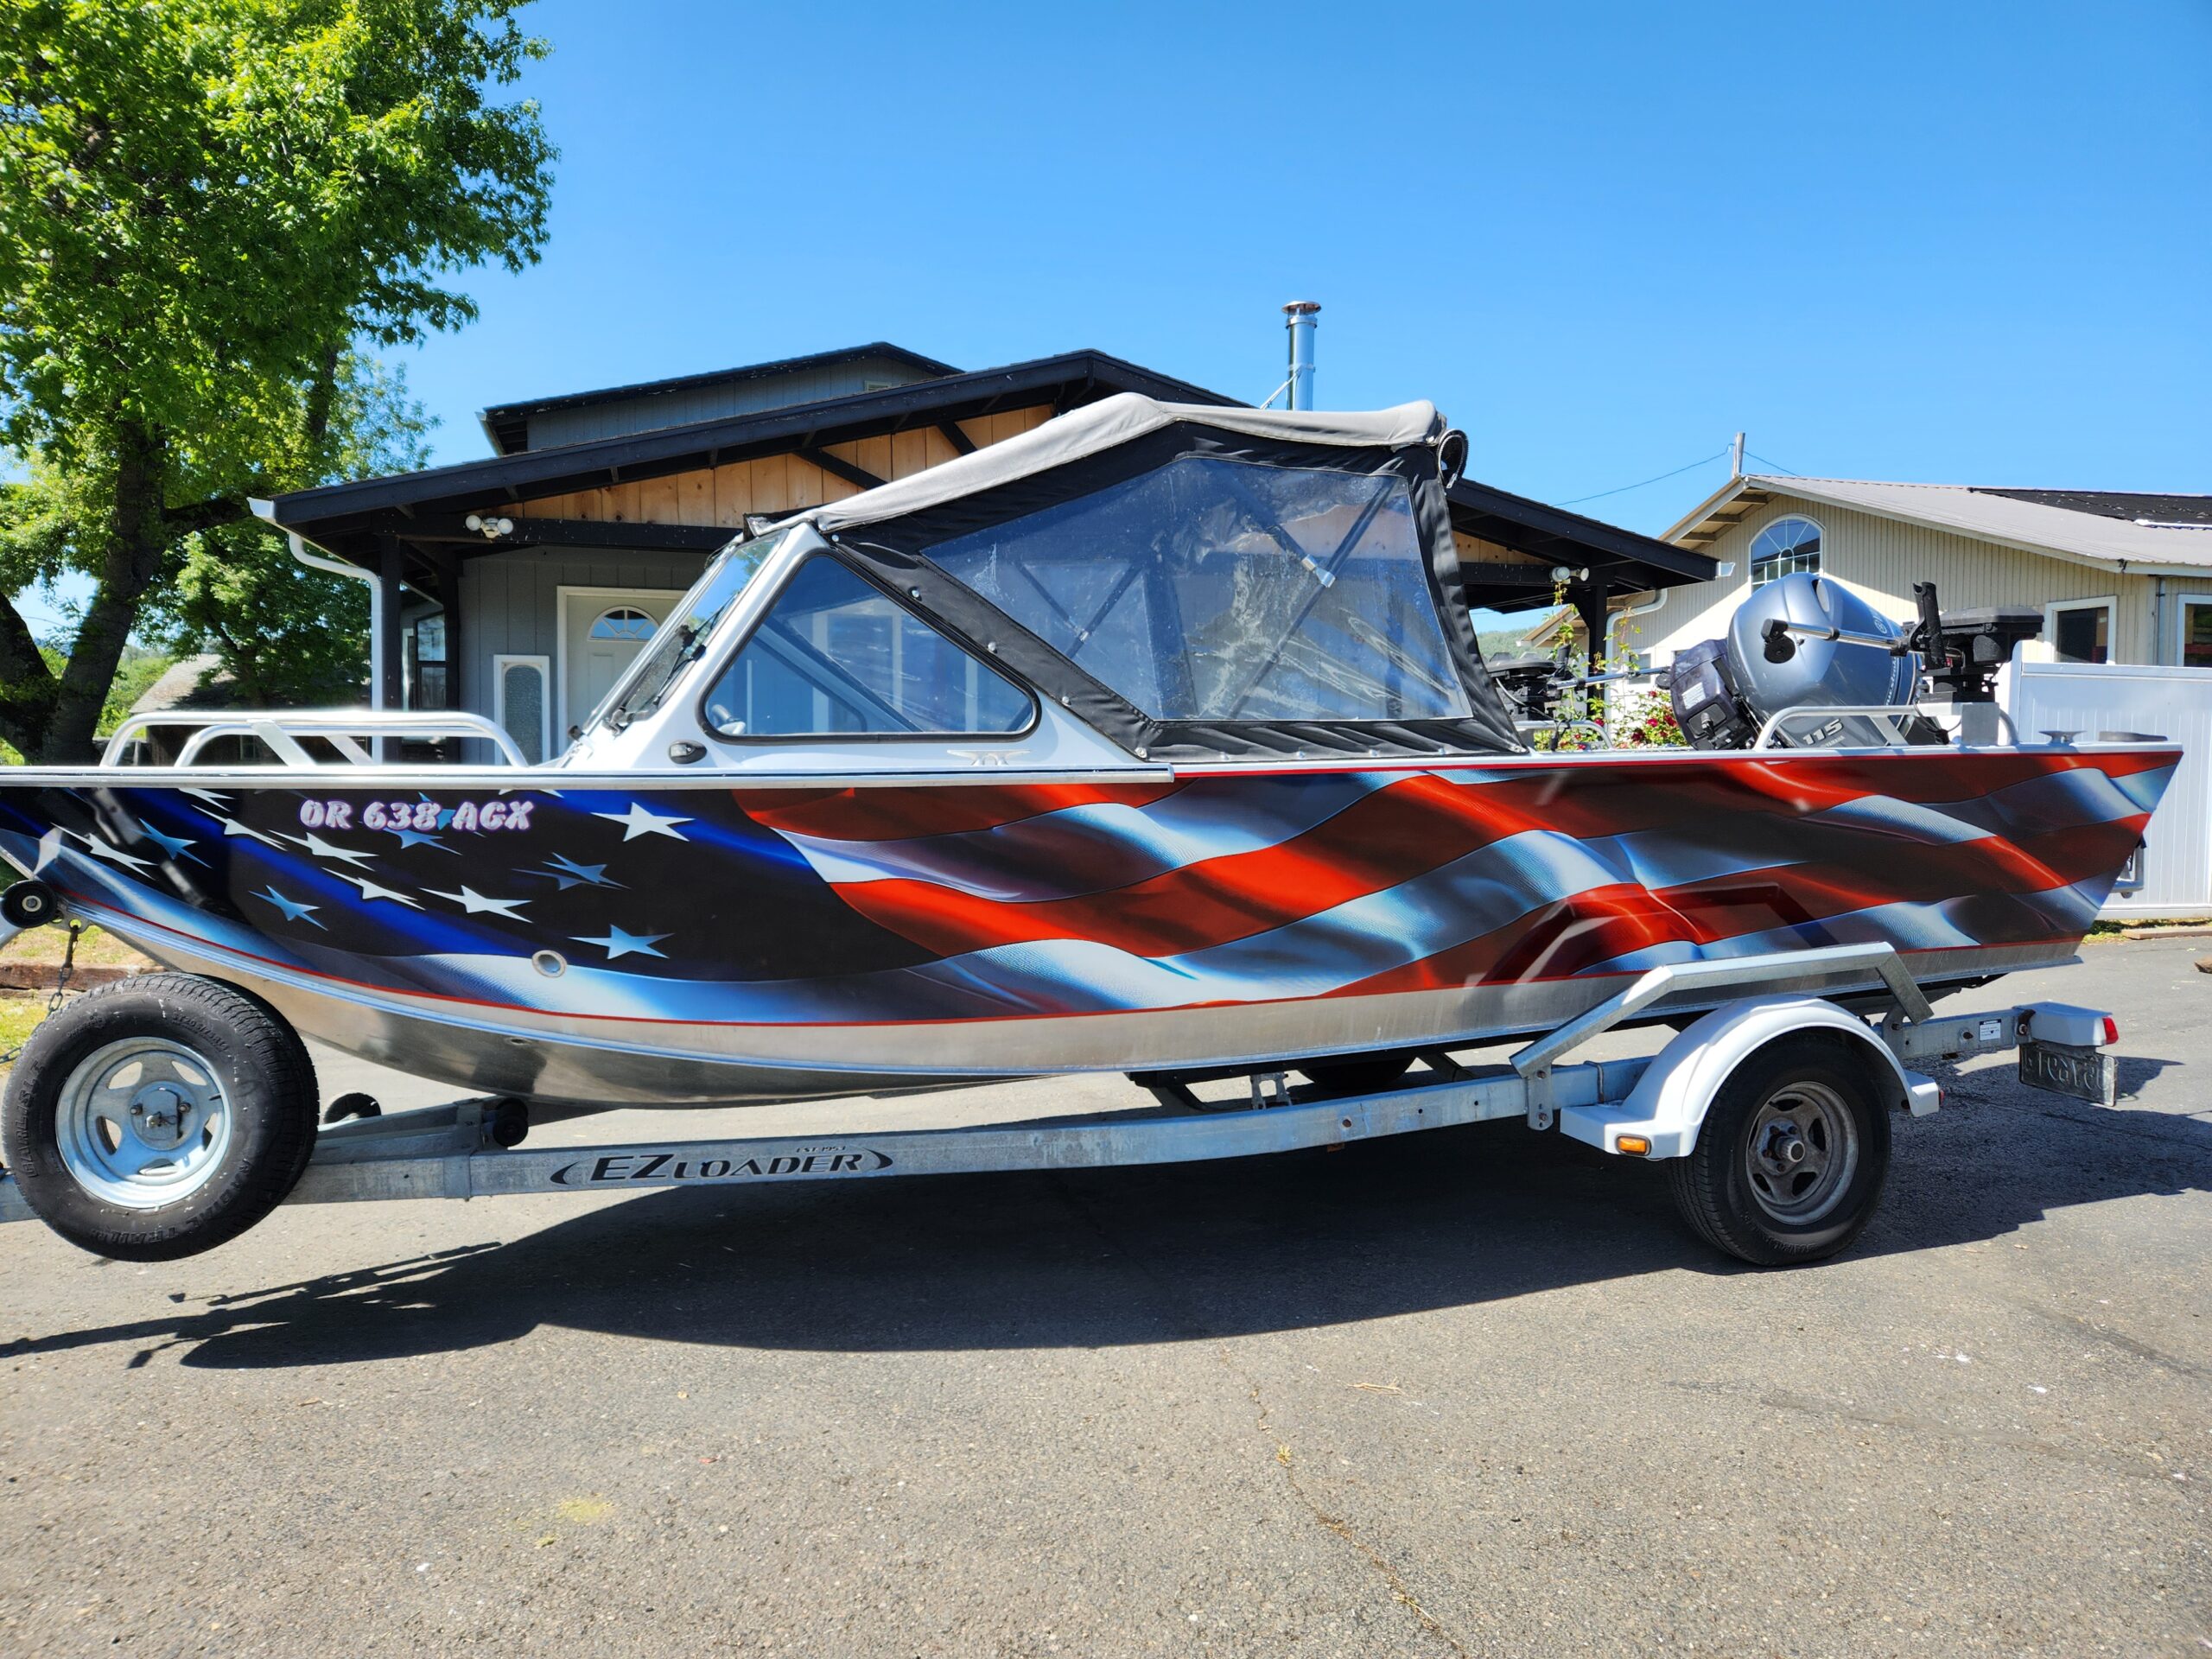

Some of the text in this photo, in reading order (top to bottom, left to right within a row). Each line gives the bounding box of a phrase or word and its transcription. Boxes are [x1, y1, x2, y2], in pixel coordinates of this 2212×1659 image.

[1802, 718, 1844, 745] 115
[300, 799, 534, 830] OR 638 AGX
